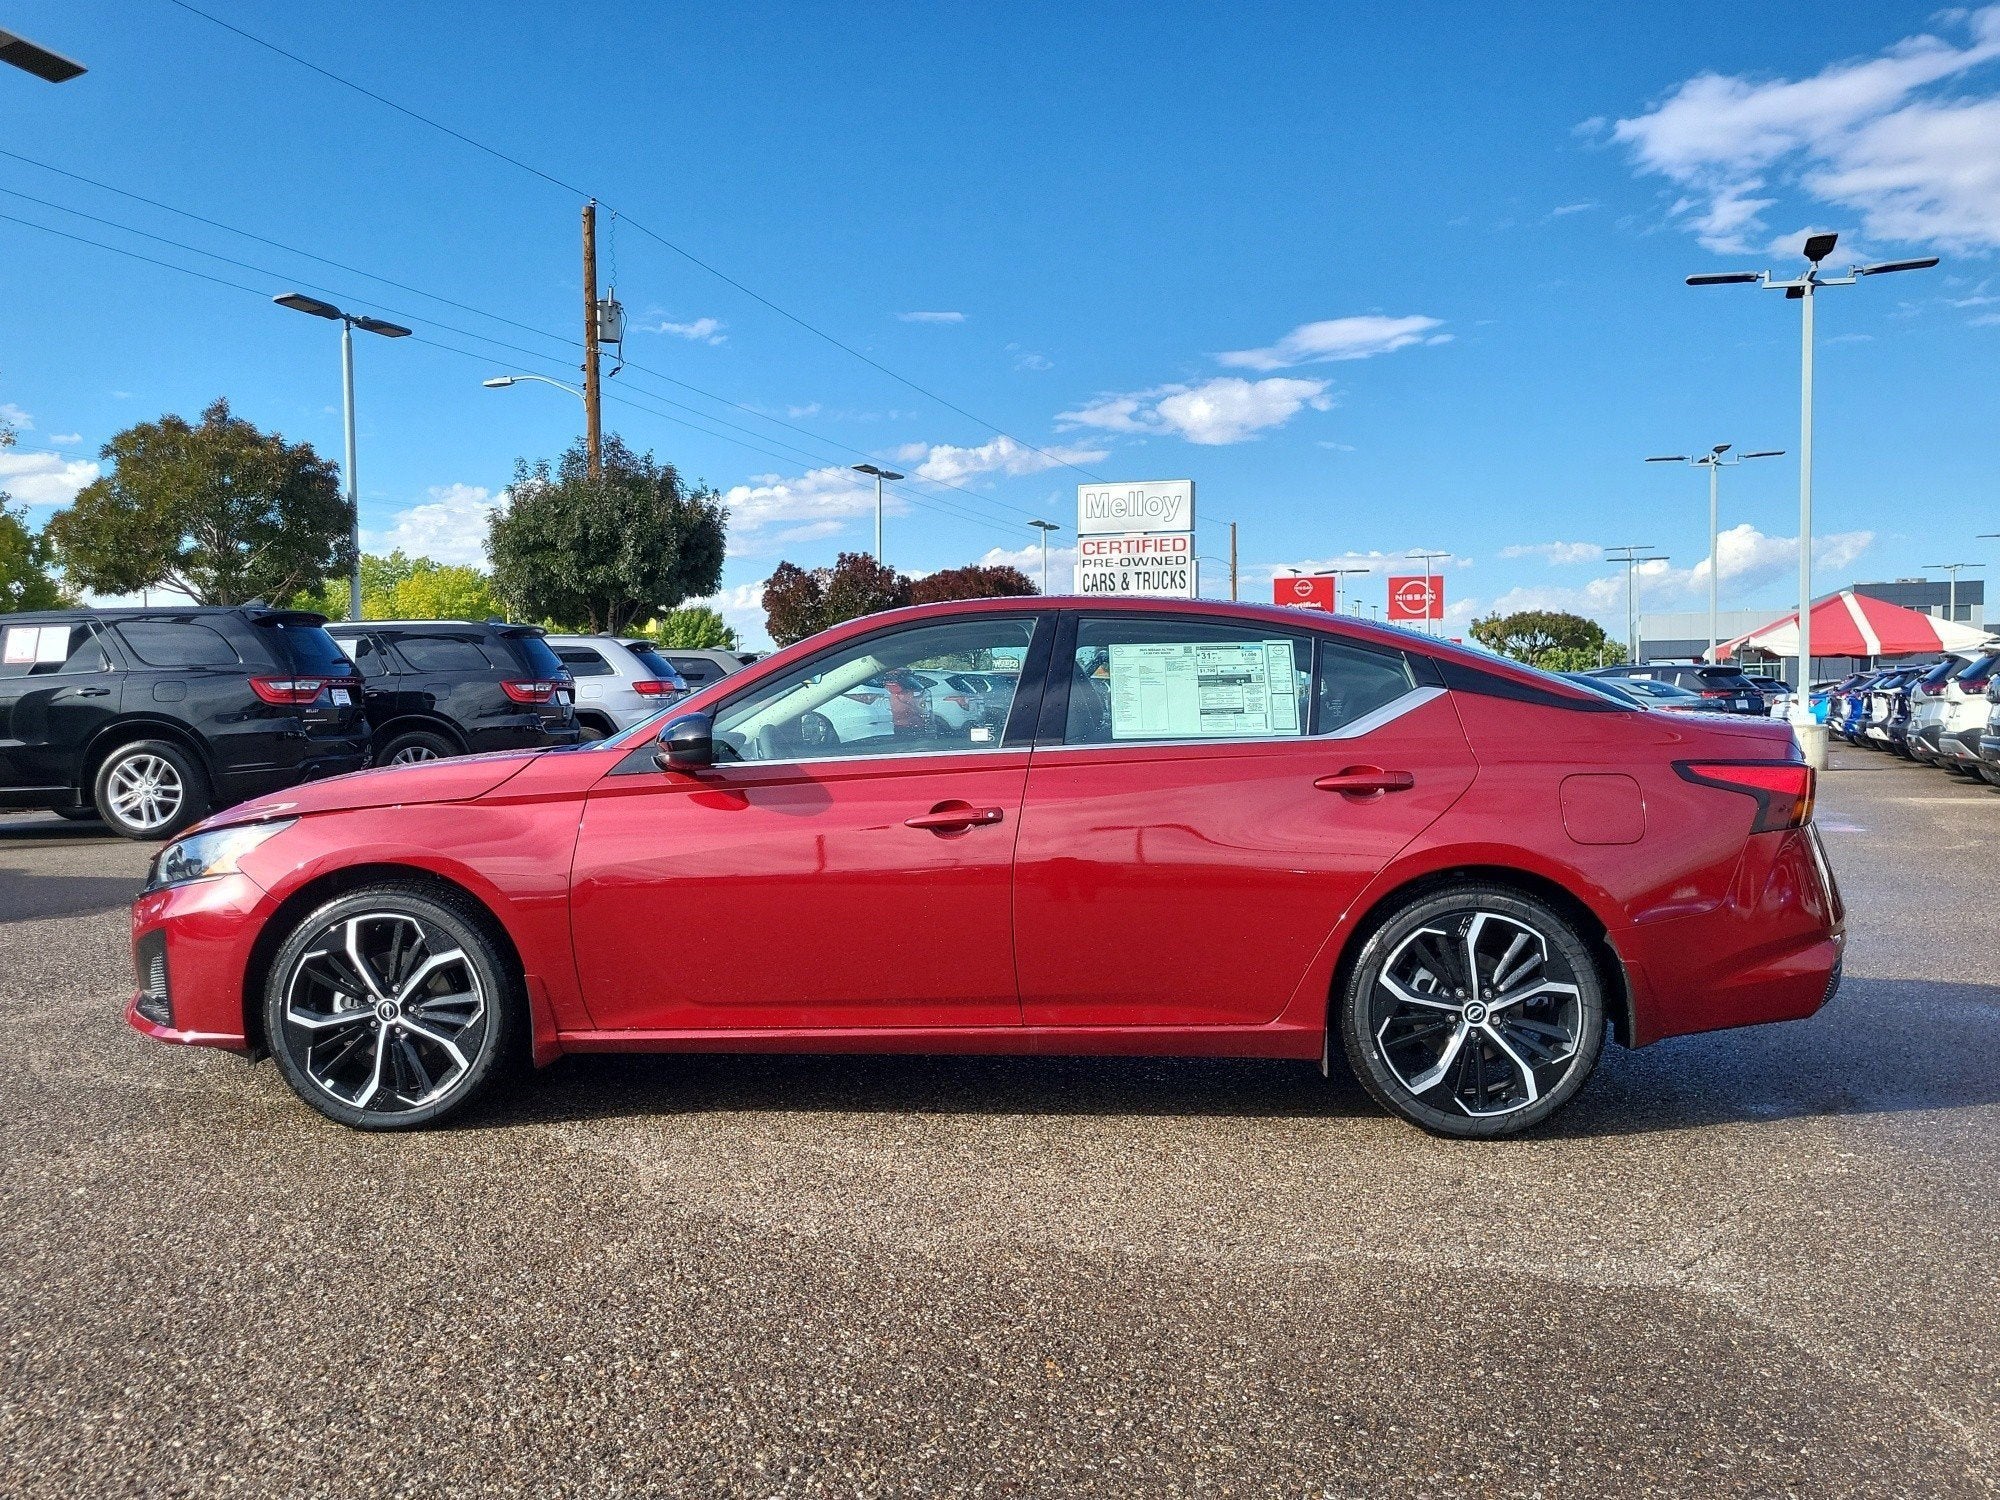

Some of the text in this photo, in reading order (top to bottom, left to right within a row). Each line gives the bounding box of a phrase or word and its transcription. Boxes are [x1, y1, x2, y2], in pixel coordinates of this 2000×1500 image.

[1085, 490, 1182, 522] Melloy
[1082, 538, 1187, 555] CERTIFIED
[1082, 555, 1187, 568] PRE-OWNED
[1082, 570, 1187, 592] CARS & TRUCKS
[1394, 593, 1437, 601] NISSAN
